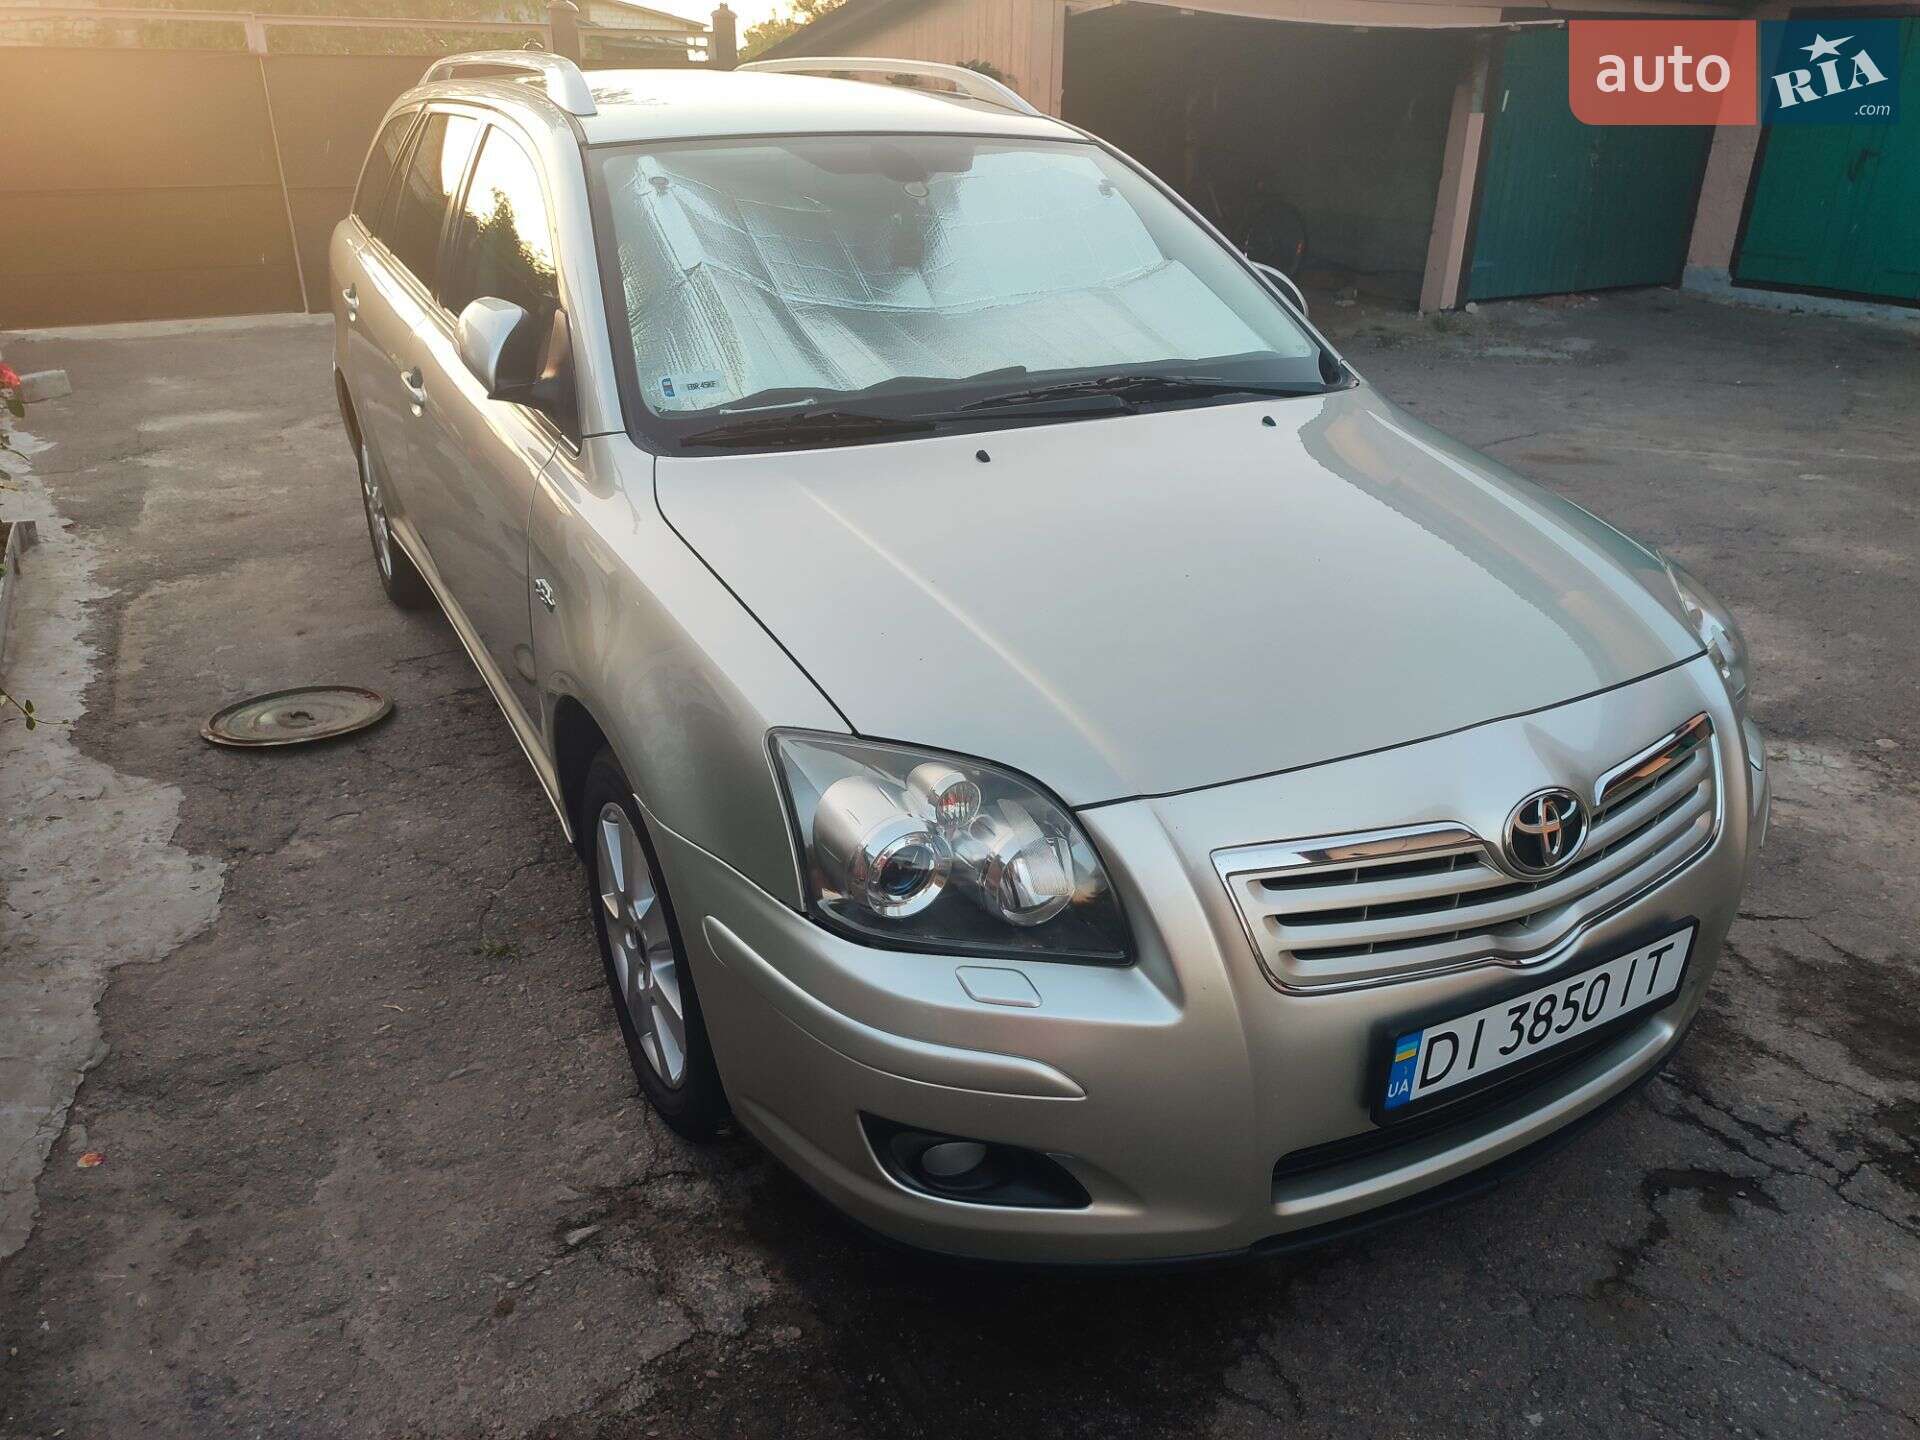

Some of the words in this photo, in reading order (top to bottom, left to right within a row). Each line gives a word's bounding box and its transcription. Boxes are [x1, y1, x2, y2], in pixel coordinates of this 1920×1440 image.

[1418, 1018, 1485, 1090] DI
[1498, 972, 1611, 1056] 3850
[1620, 942, 1675, 1007] IT
[1388, 1079, 1409, 1098] UA
